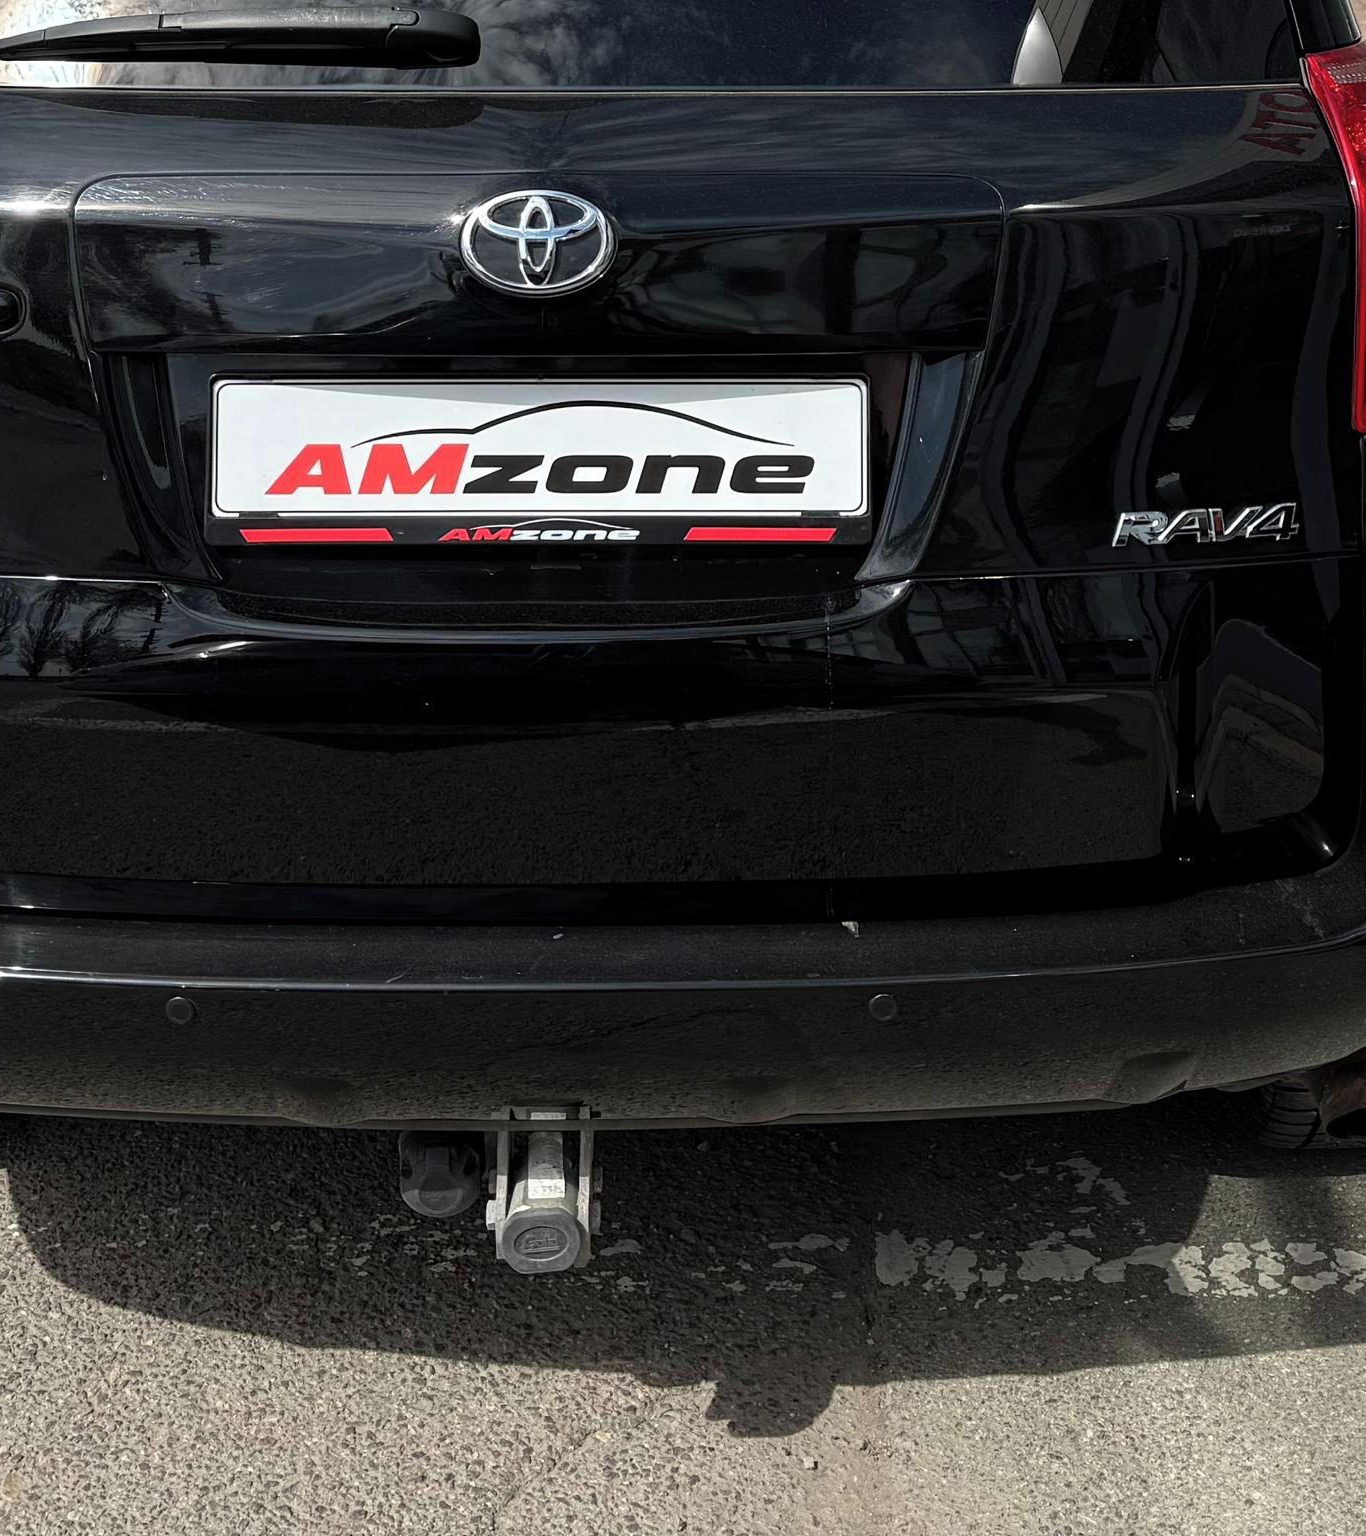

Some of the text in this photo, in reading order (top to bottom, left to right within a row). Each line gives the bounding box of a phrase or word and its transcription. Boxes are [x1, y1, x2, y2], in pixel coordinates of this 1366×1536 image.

[265, 443, 815, 496] AMzone
[438, 527, 641, 542] AMzone
[1112, 502, 1299, 547] RAV4
